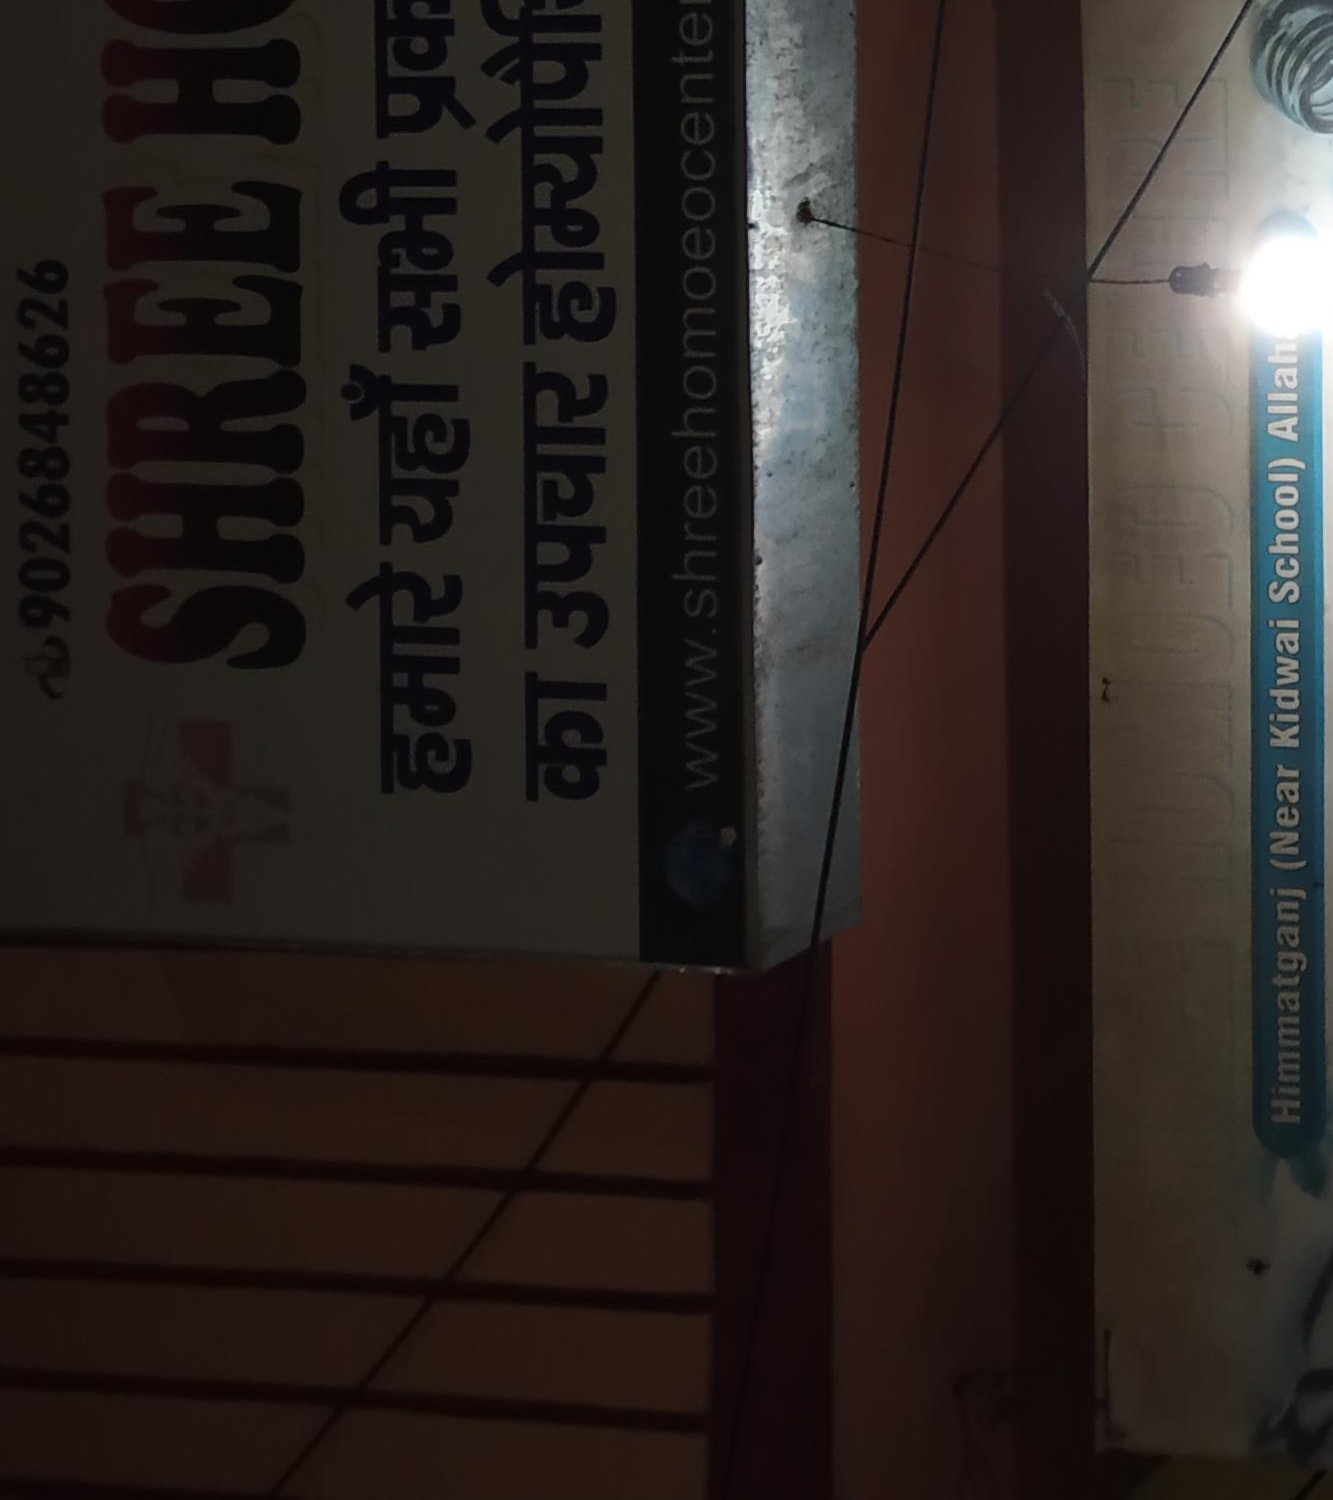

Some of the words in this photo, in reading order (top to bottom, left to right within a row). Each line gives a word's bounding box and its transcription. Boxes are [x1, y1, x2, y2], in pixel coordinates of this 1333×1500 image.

[338, 161, 458, 352] सभी
[16, 259, 72, 629] 9026848626
[100, 179, 307, 671] SHREE
[339, 364, 470, 546] यहाँ
[519, 363, 613, 650] उपचार
[1267, 458, 1306, 603] School)
[346, 562, 472, 794] हमारे
[521, 672, 610, 801] का
[1268, 620, 1300, 748] Kidwai
[1268, 764, 1307, 871] (Near
[1270, 888, 1308, 1124] Himmatganj
